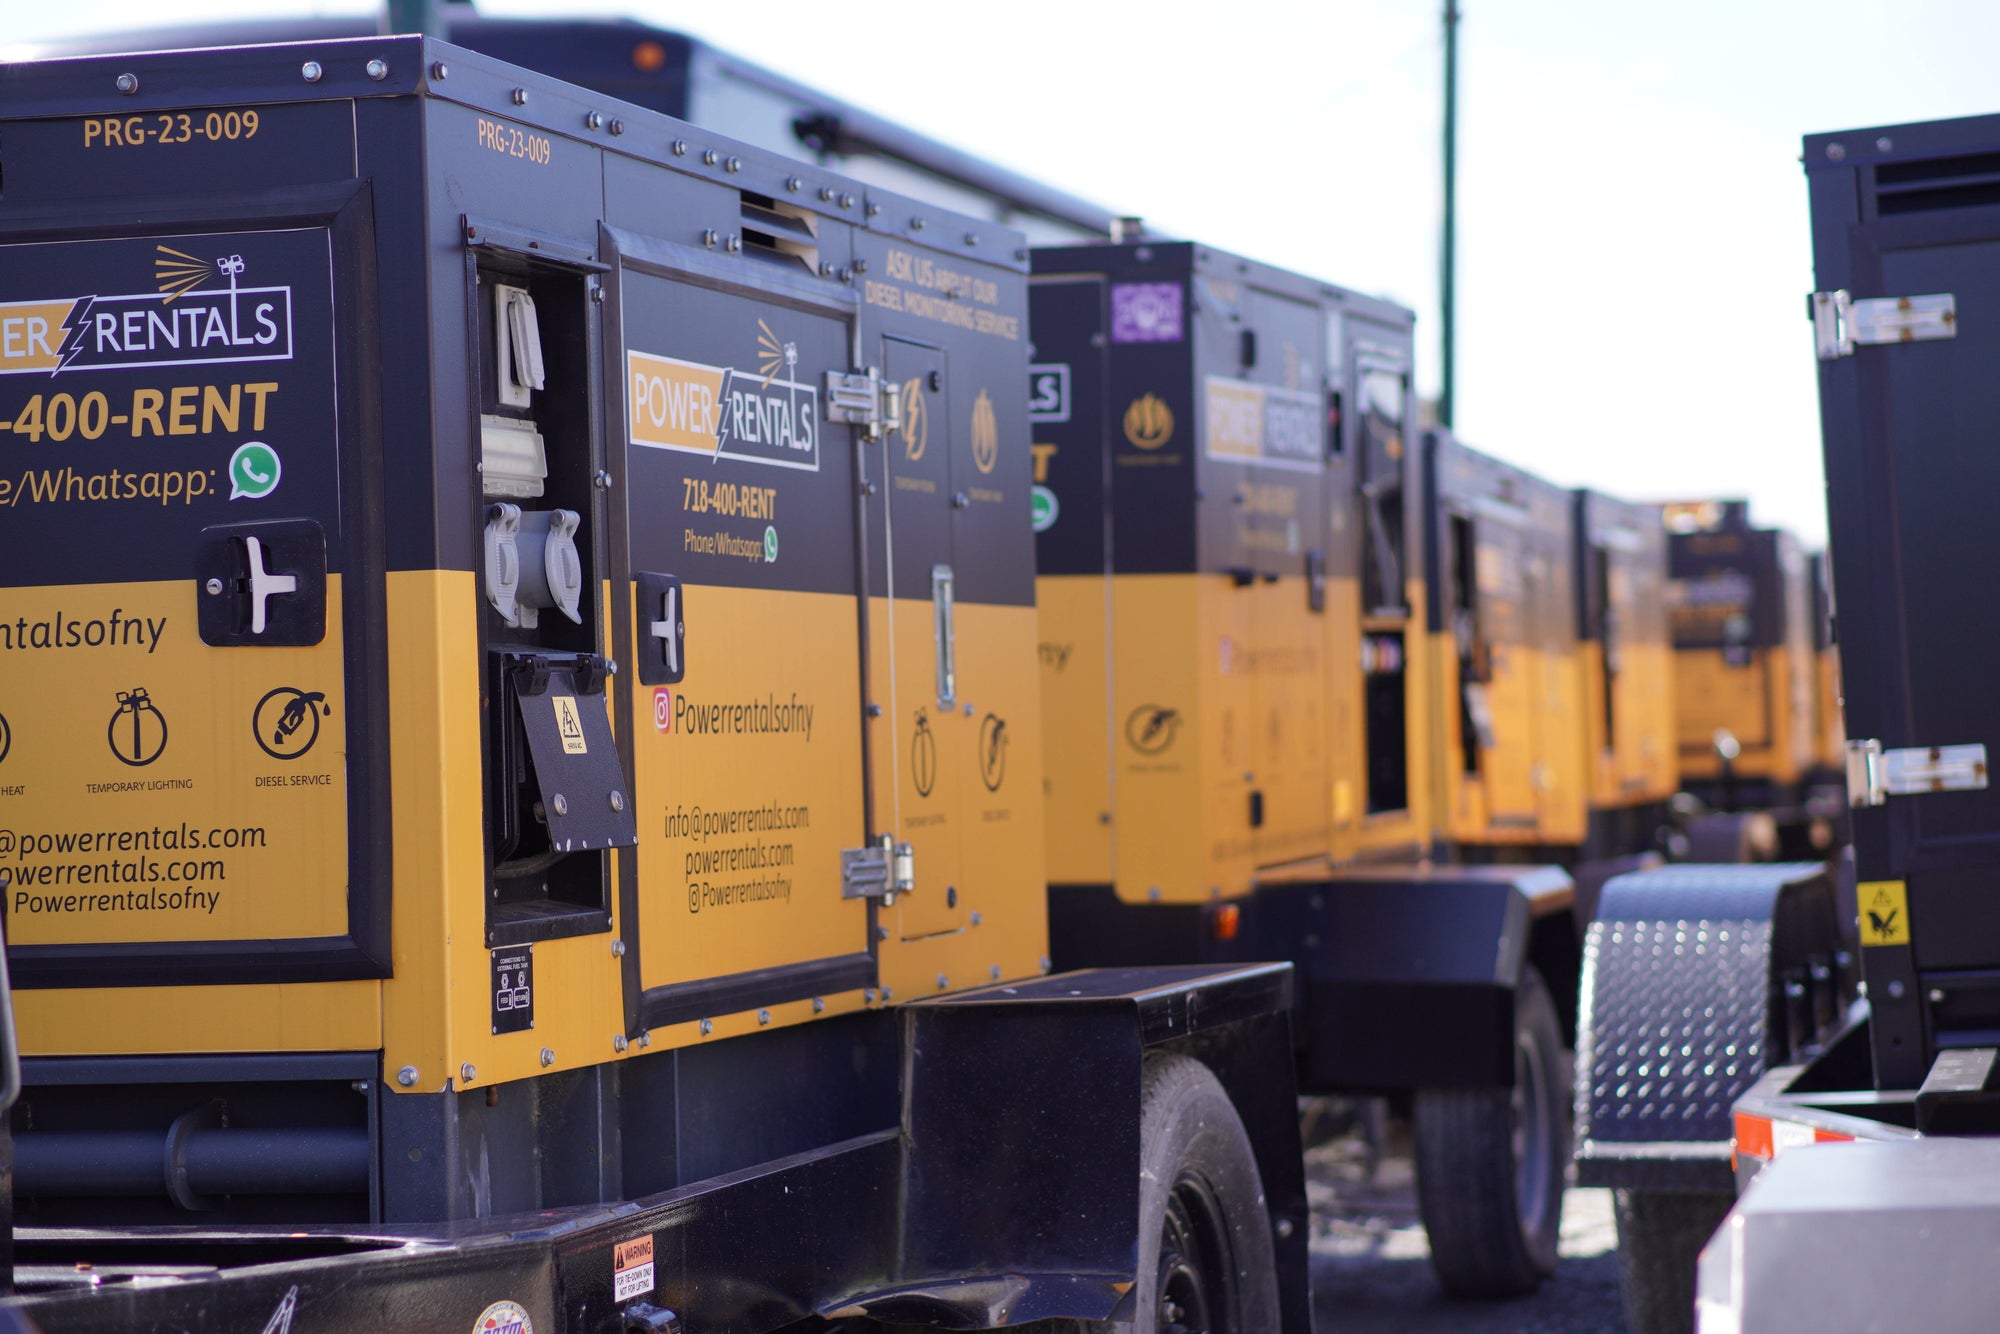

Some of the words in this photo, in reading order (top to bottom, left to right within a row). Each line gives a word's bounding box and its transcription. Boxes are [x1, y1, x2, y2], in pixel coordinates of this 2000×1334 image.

[84, 111, 260, 148] PRG-23-009
[478, 118, 551, 165] PRG-23-009
[886, 249, 914, 283] ASK
[914, 256, 934, 289] US
[3, 316, 54, 358] ER
[96, 302, 279, 353] RENTALS
[0, 382, 279, 443] -400-RENT
[634, 372, 715, 437] POWER
[731, 390, 814, 452] RENTALS
[683, 477, 776, 521] 718-400-RENT
[684, 527, 764, 563] Phone/Whatsapp:
[675, 692, 815, 743] Powerrentalsofny
[1, 785, 26, 796] HEAT
[86, 781, 145, 794] TEMPORARY
[147, 778, 193, 791] LIGHTING
[254, 776, 288, 787] DIESEL
[290, 775, 332, 787] SERVICE
[664, 799, 810, 843] info@powerrentals.com
[685, 840, 794, 883] powerrentals.com
[15, 886, 220, 915] Powerrentalsofny
[702, 874, 792, 908] Powerrentalsofny
[625, 1241, 652, 1261] WARNING
